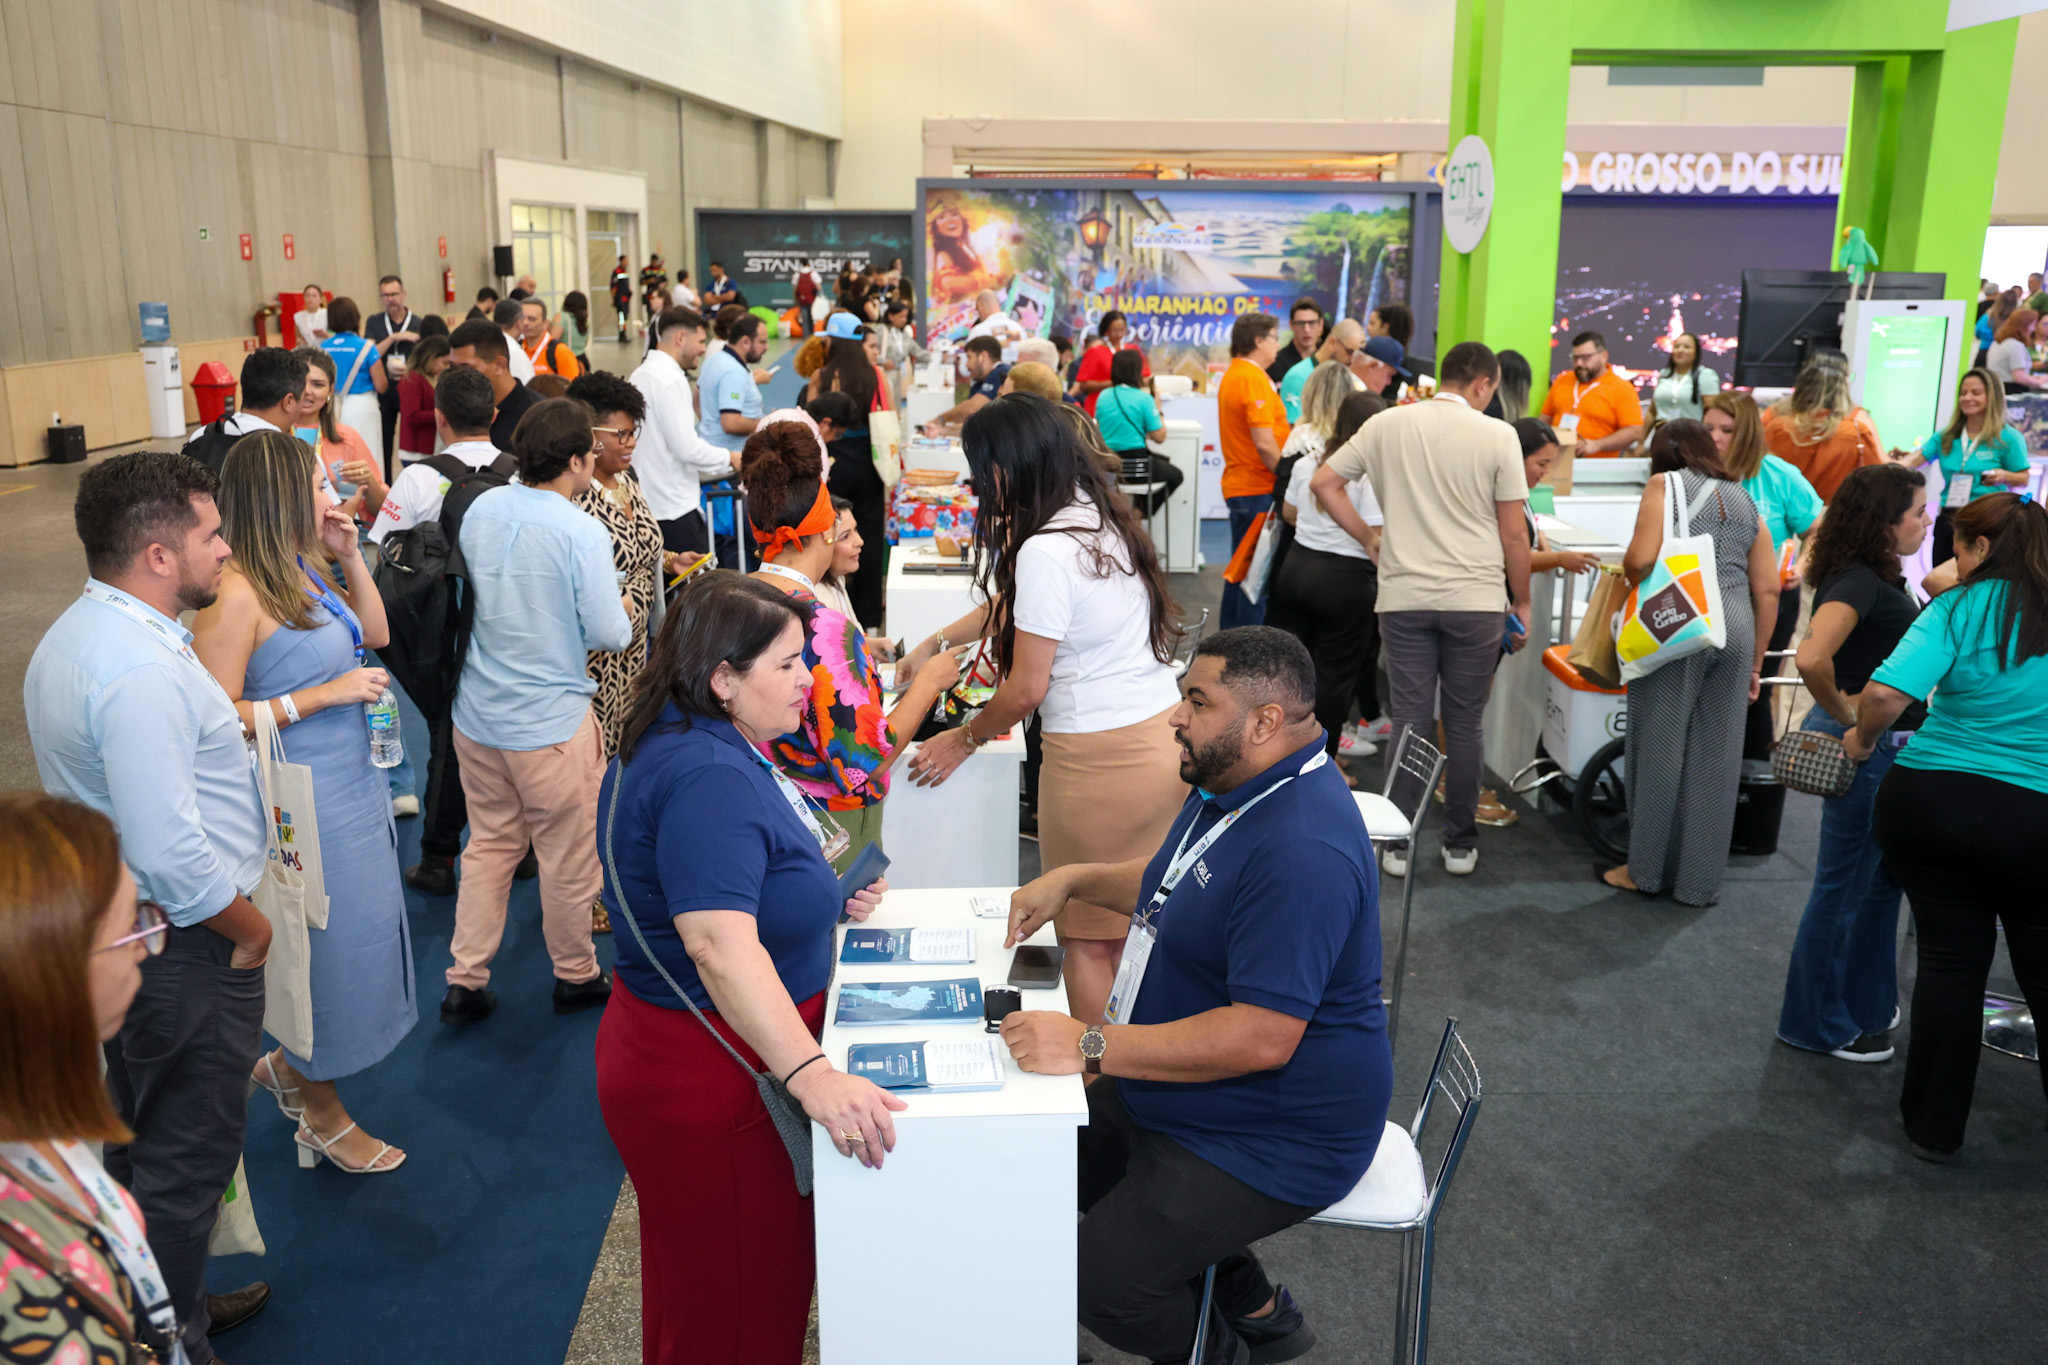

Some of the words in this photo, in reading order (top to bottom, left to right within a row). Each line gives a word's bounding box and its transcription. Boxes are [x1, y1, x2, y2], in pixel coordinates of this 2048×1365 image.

[1590, 151, 1722, 194] GROSSO
[1729, 150, 1782, 195] DO
[1787, 154, 1843, 195] SUL
[1084, 296, 1112, 313] UM
[1118, 291, 1228, 316] MARANHÃO
[1233, 296, 1261, 316] DE
[112, 596, 129, 607] BTM
[1194, 842, 1207, 857] BTM
